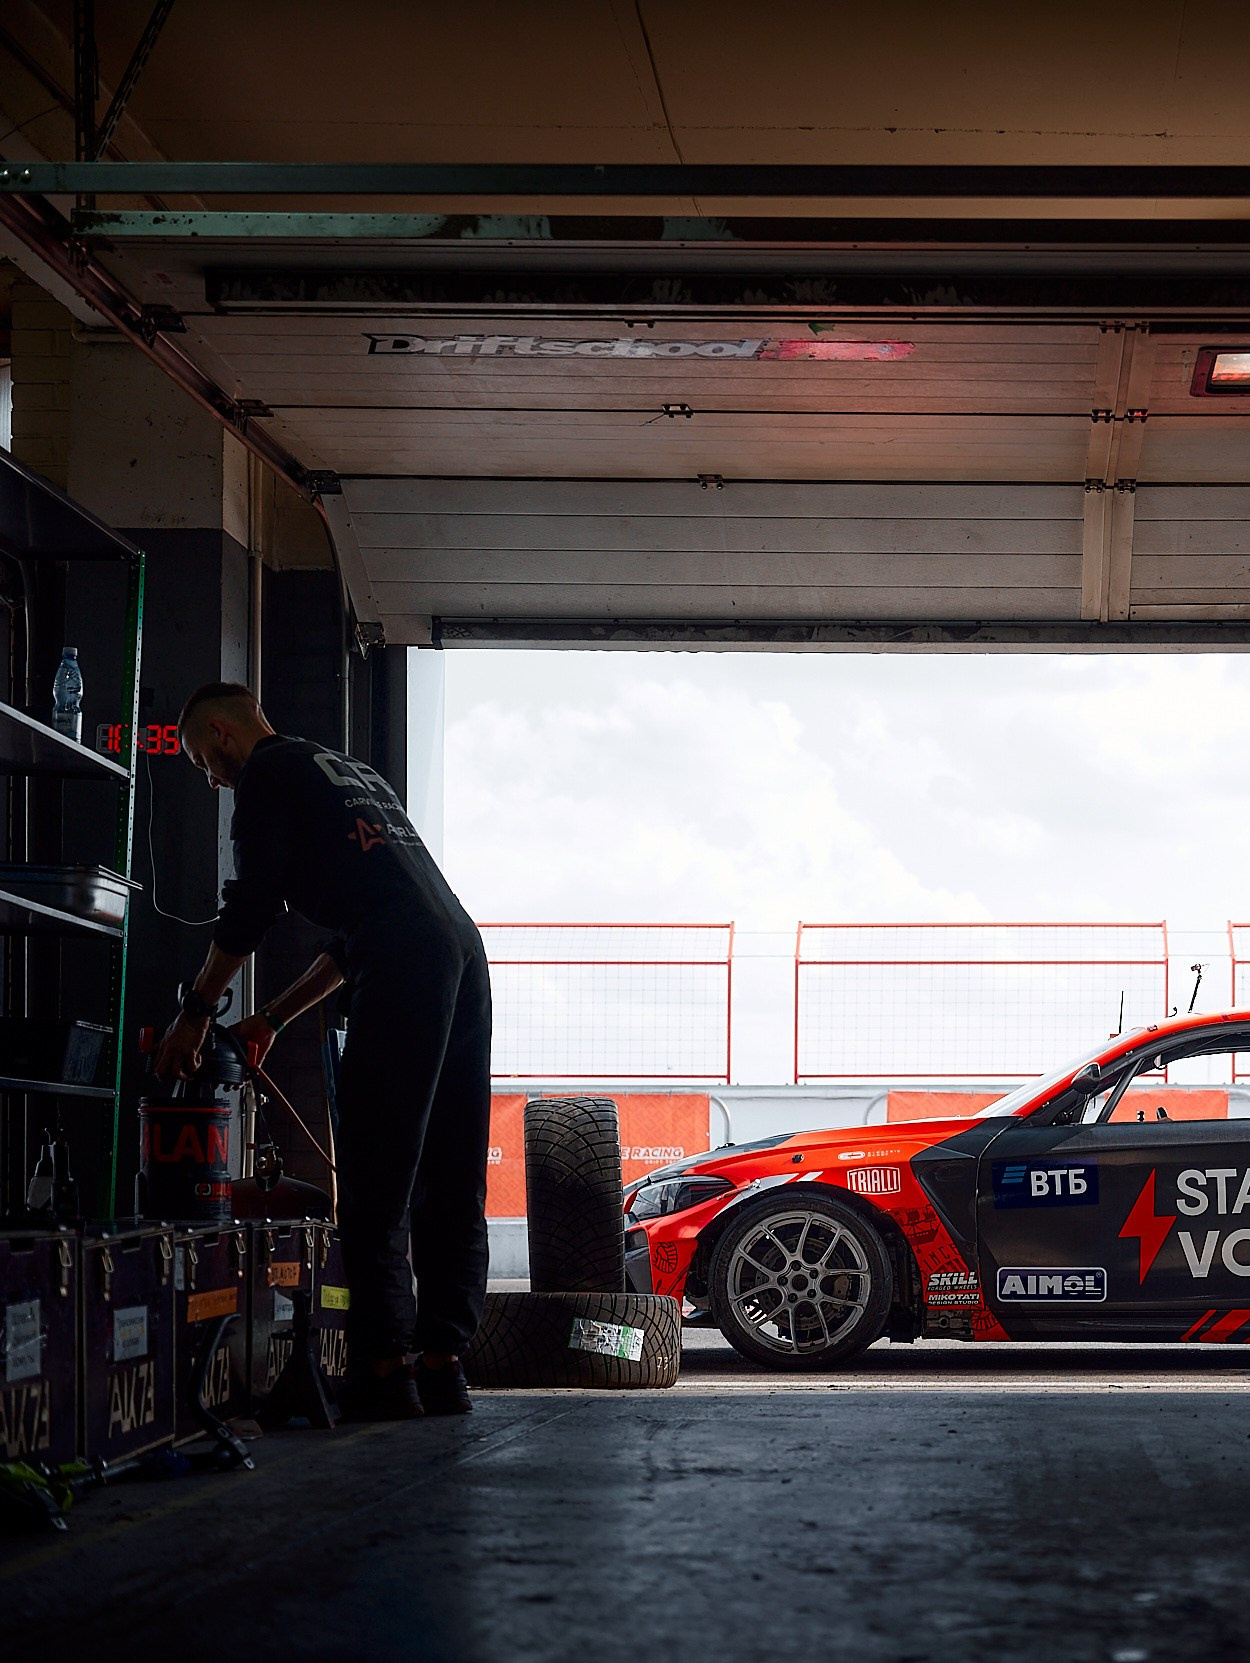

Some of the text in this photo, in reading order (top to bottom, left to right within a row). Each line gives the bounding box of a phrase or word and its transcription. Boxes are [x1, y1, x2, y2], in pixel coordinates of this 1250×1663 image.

[632, 1148, 682, 1158] RACING
[849, 1169, 898, 1193] TRIALLI
[1030, 1168, 1088, 1197] ВТБ
[928, 1271, 978, 1287] SKILL
[1001, 1274, 1102, 1295] AIMOL
[928, 1293, 980, 1301] MIKOTATI
